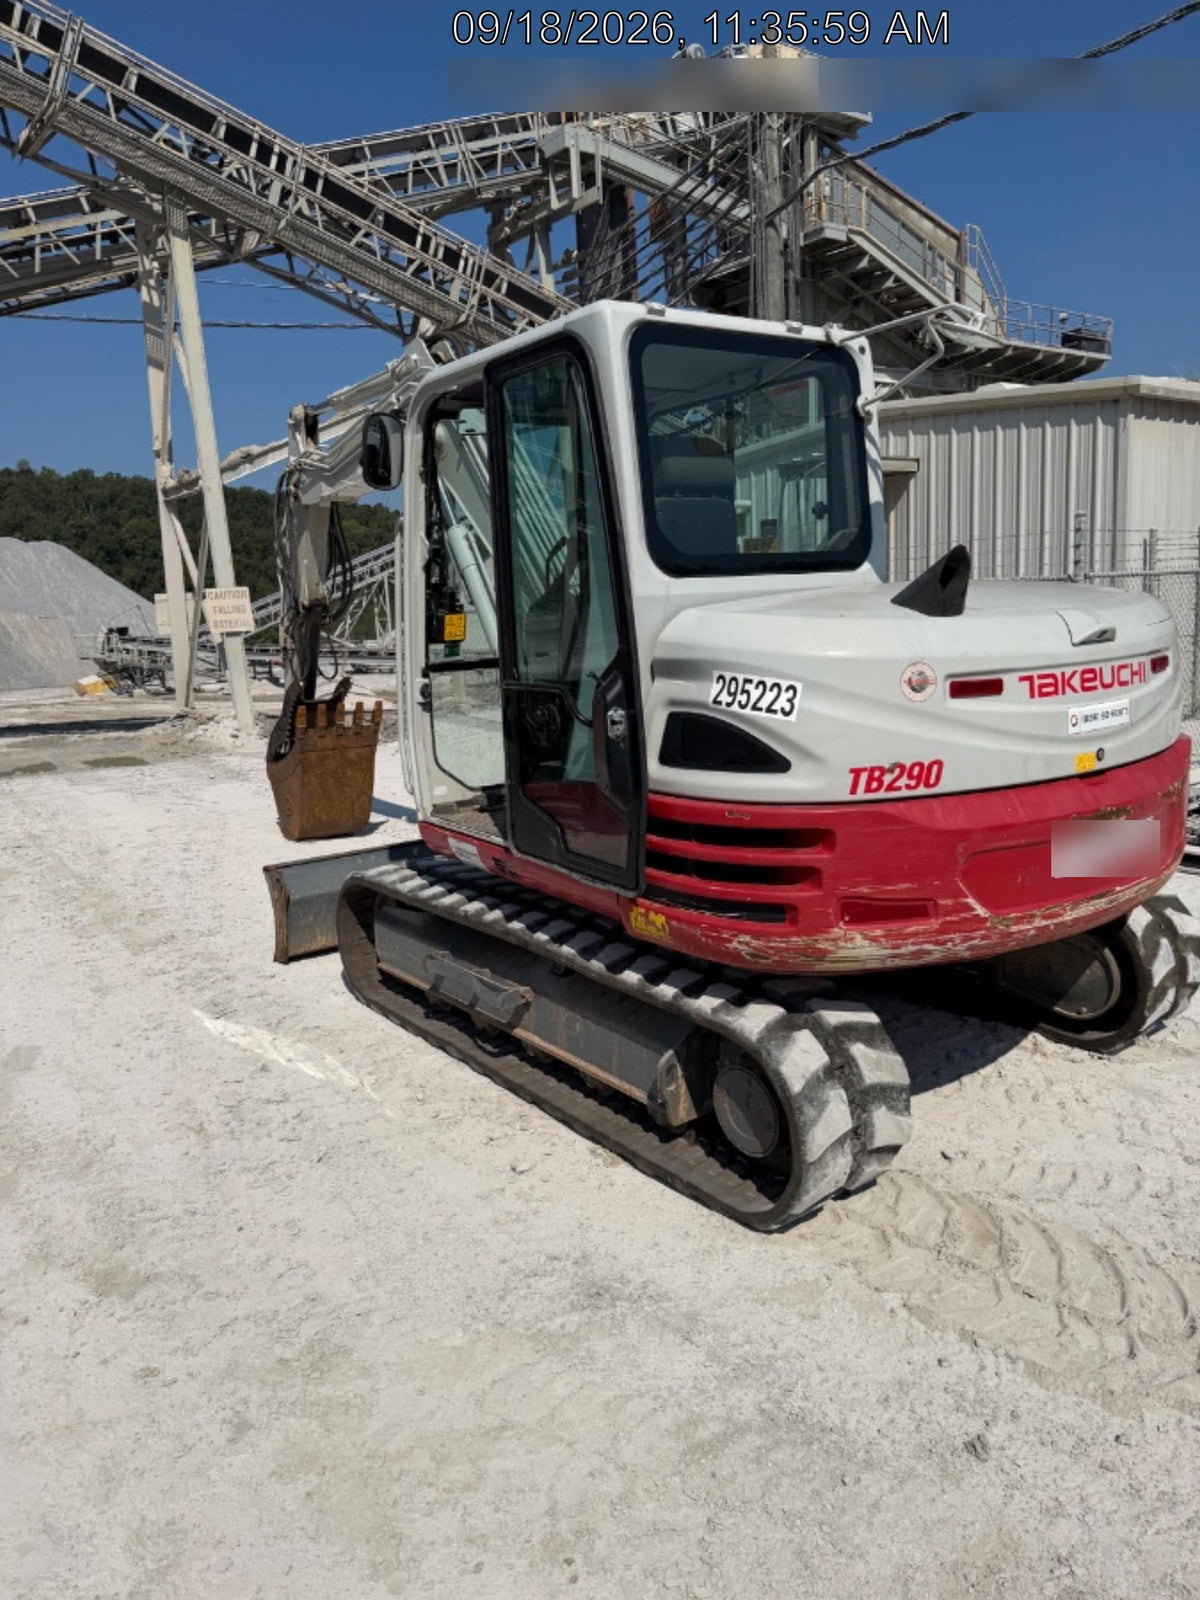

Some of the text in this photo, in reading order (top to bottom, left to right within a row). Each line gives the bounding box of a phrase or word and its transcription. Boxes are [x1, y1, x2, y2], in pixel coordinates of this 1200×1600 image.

[207, 590, 248, 600] CAUTION
[213, 604, 246, 614] FALLING
[711, 674, 798, 717] 295223
[849, 759, 944, 796] TB290
